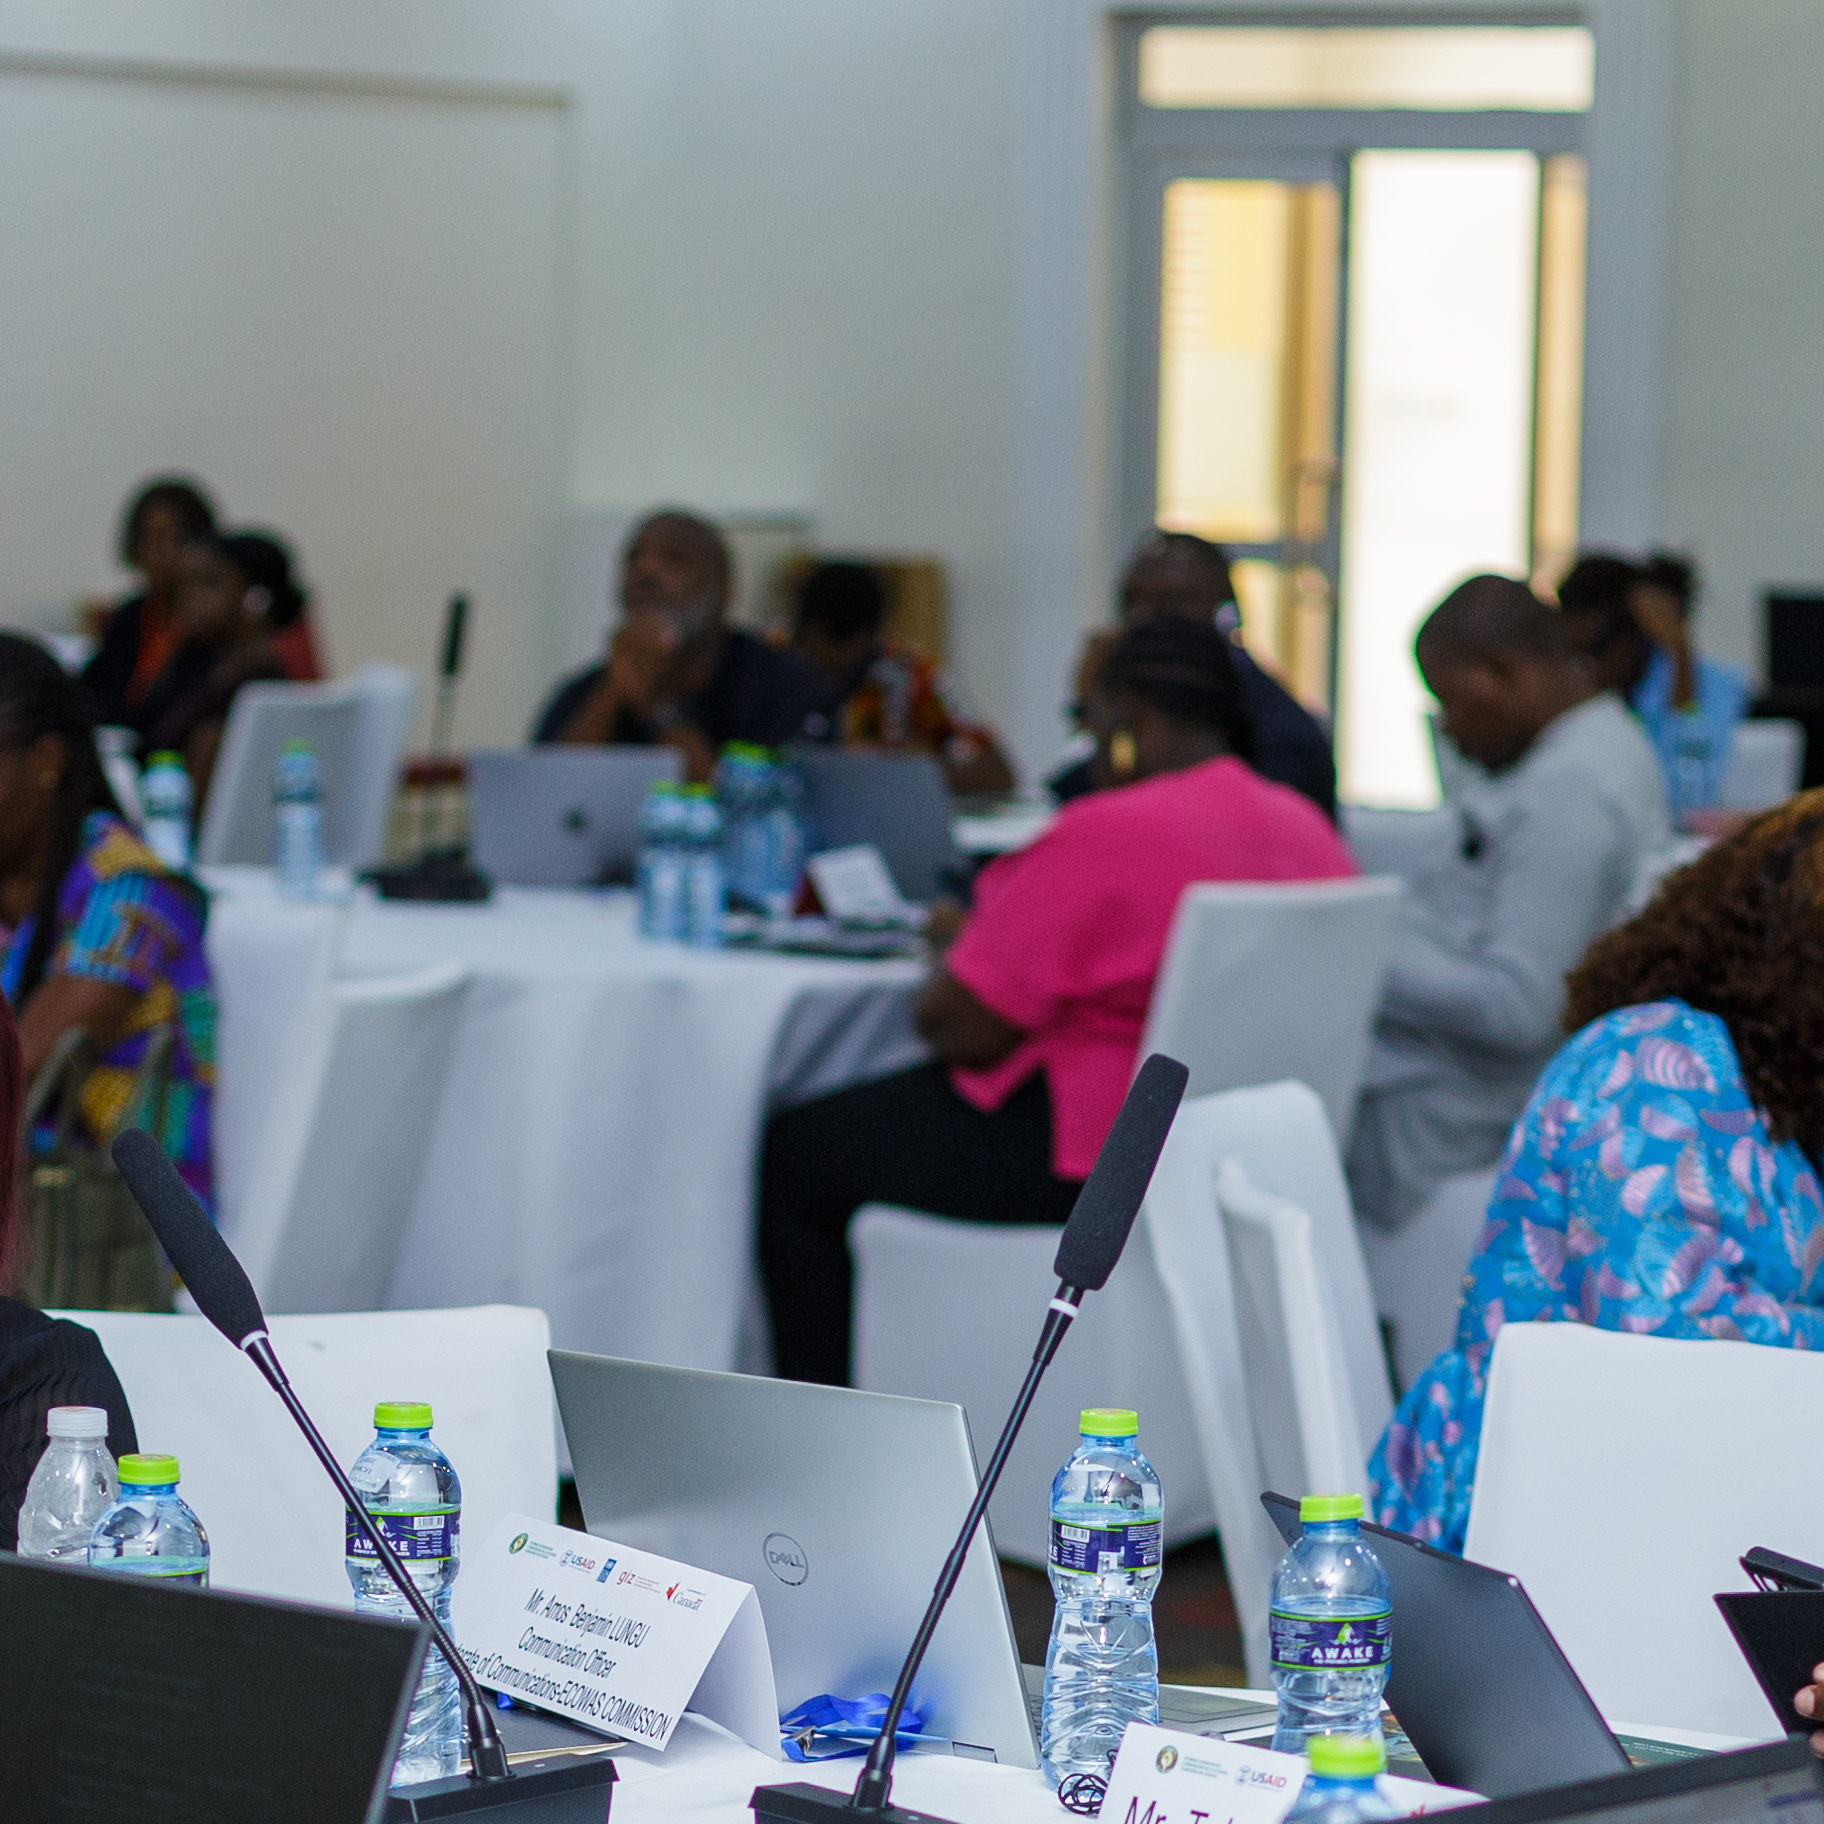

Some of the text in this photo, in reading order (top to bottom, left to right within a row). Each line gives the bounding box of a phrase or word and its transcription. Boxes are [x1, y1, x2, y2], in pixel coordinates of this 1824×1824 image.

[353, 1538, 408, 1552] AWKE
[570, 1554, 596, 1570] USAID
[768, 1550, 805, 1568] DELL
[616, 1569, 636, 1586] giz
[672, 1591, 703, 1611] Canada
[524, 1587, 651, 1649] Mr. Amos Benjamin LUNGU
[518, 1626, 617, 1679] Communication Officer
[1311, 1646, 1373, 1659] AWAKE
[477, 1652, 496, 1675] of
[601, 1695, 674, 1742] COMMISSION
[1250, 1770, 1287, 1788] USAID
